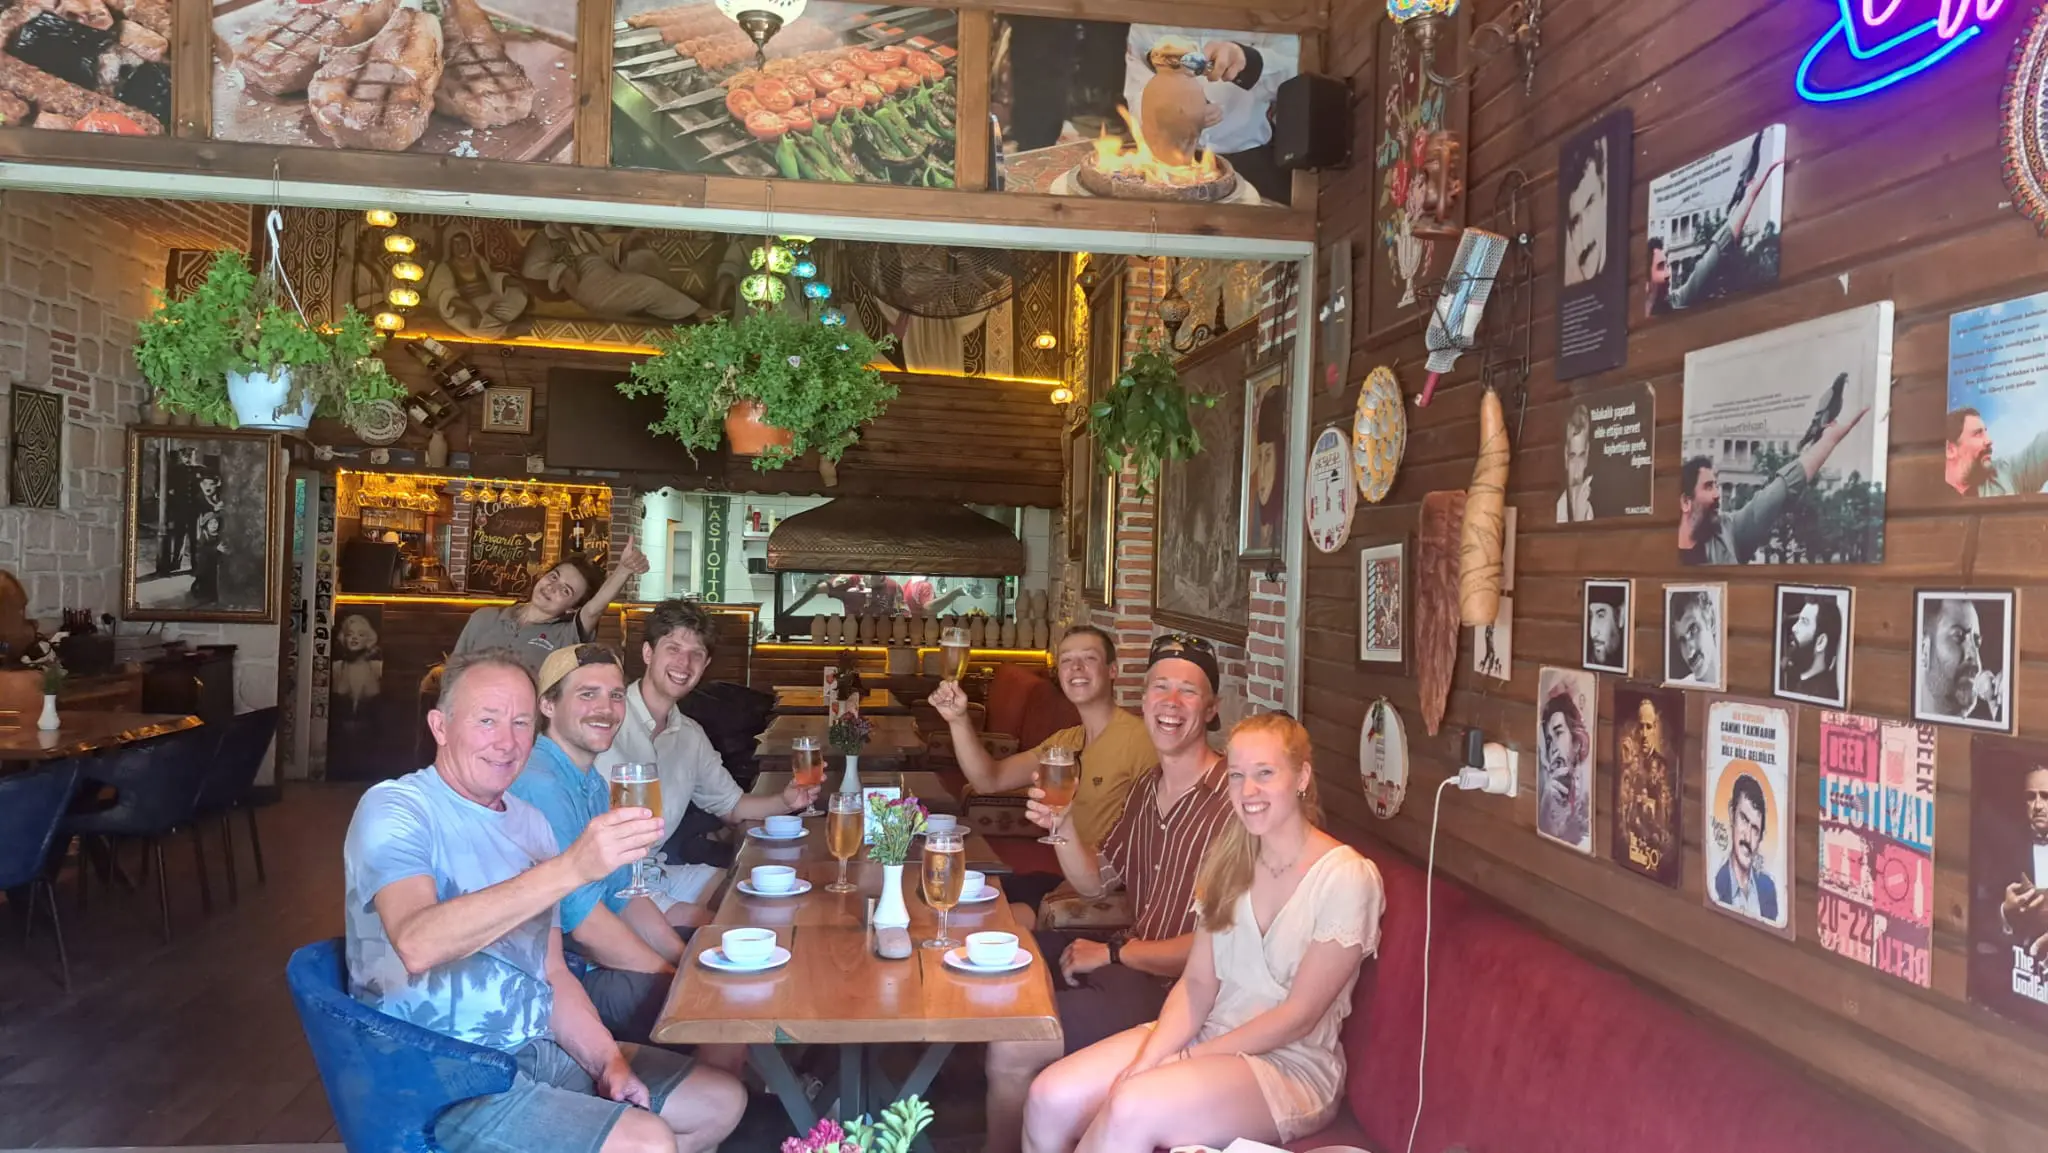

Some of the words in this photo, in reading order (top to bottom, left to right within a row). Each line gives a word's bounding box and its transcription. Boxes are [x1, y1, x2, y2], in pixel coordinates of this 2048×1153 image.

[473, 529, 526, 546] Margarita
[1828, 735, 1865, 773] BEER
[1916, 724, 1934, 794] BEER
[1824, 774, 1934, 846] FESTIVAL
[1818, 895, 1873, 946] 20-22
[2012, 945, 2034, 973] The
